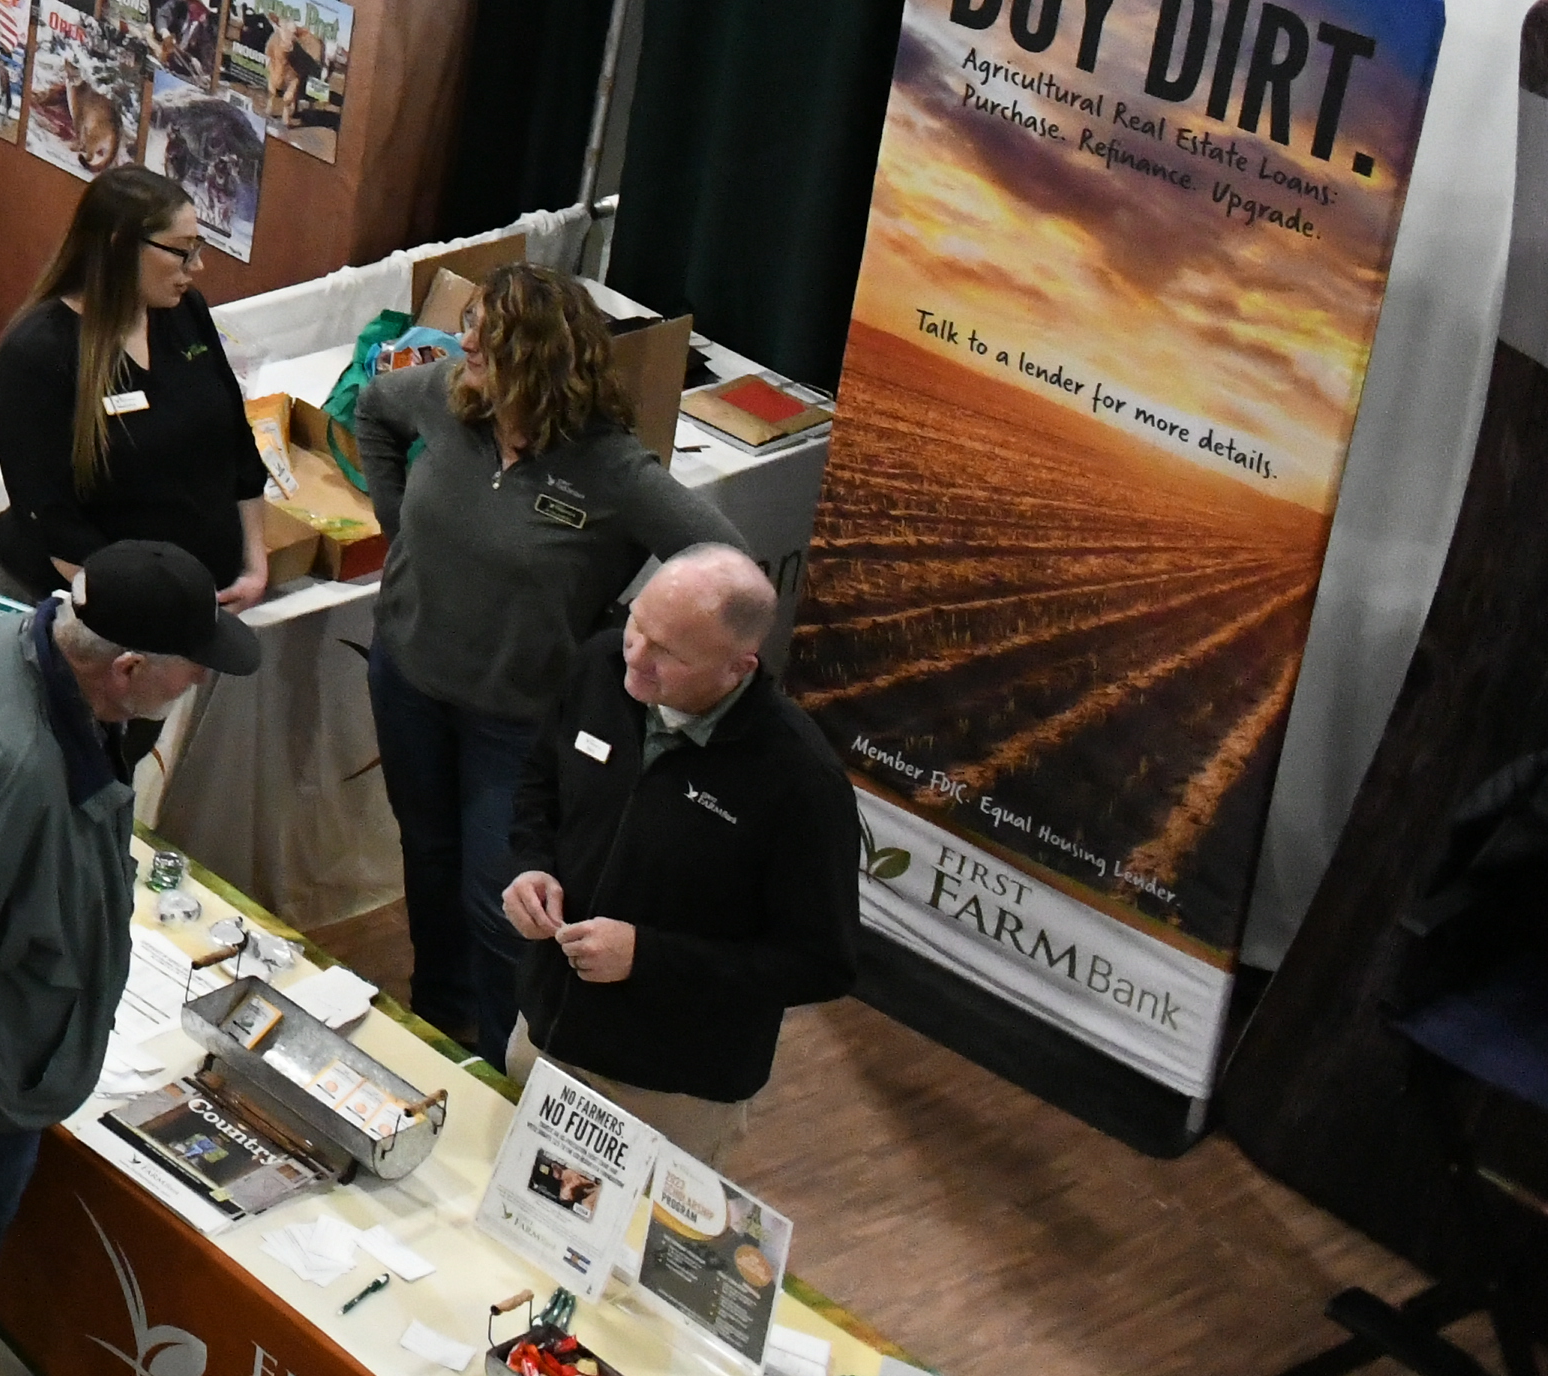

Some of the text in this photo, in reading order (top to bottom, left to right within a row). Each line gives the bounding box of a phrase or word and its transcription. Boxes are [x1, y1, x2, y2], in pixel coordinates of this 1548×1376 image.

[962, 47, 1338, 209] Agricultural Real Estate Loans:
[962, 84, 1322, 242] Purchase. Refinance. Upgrade.
[915, 308, 1279, 482] Talk to a lender for more details.
[851, 736, 1181, 907] Member FDIC. Equal Housing Lender.
[938, 845, 1032, 905] FIRST
[187, 1096, 276, 1168] Country
[539, 1095, 566, 1127] NO
[565, 1113, 629, 1170] FUTURE.
[560, 1085, 625, 1139] NO FARMERS.
